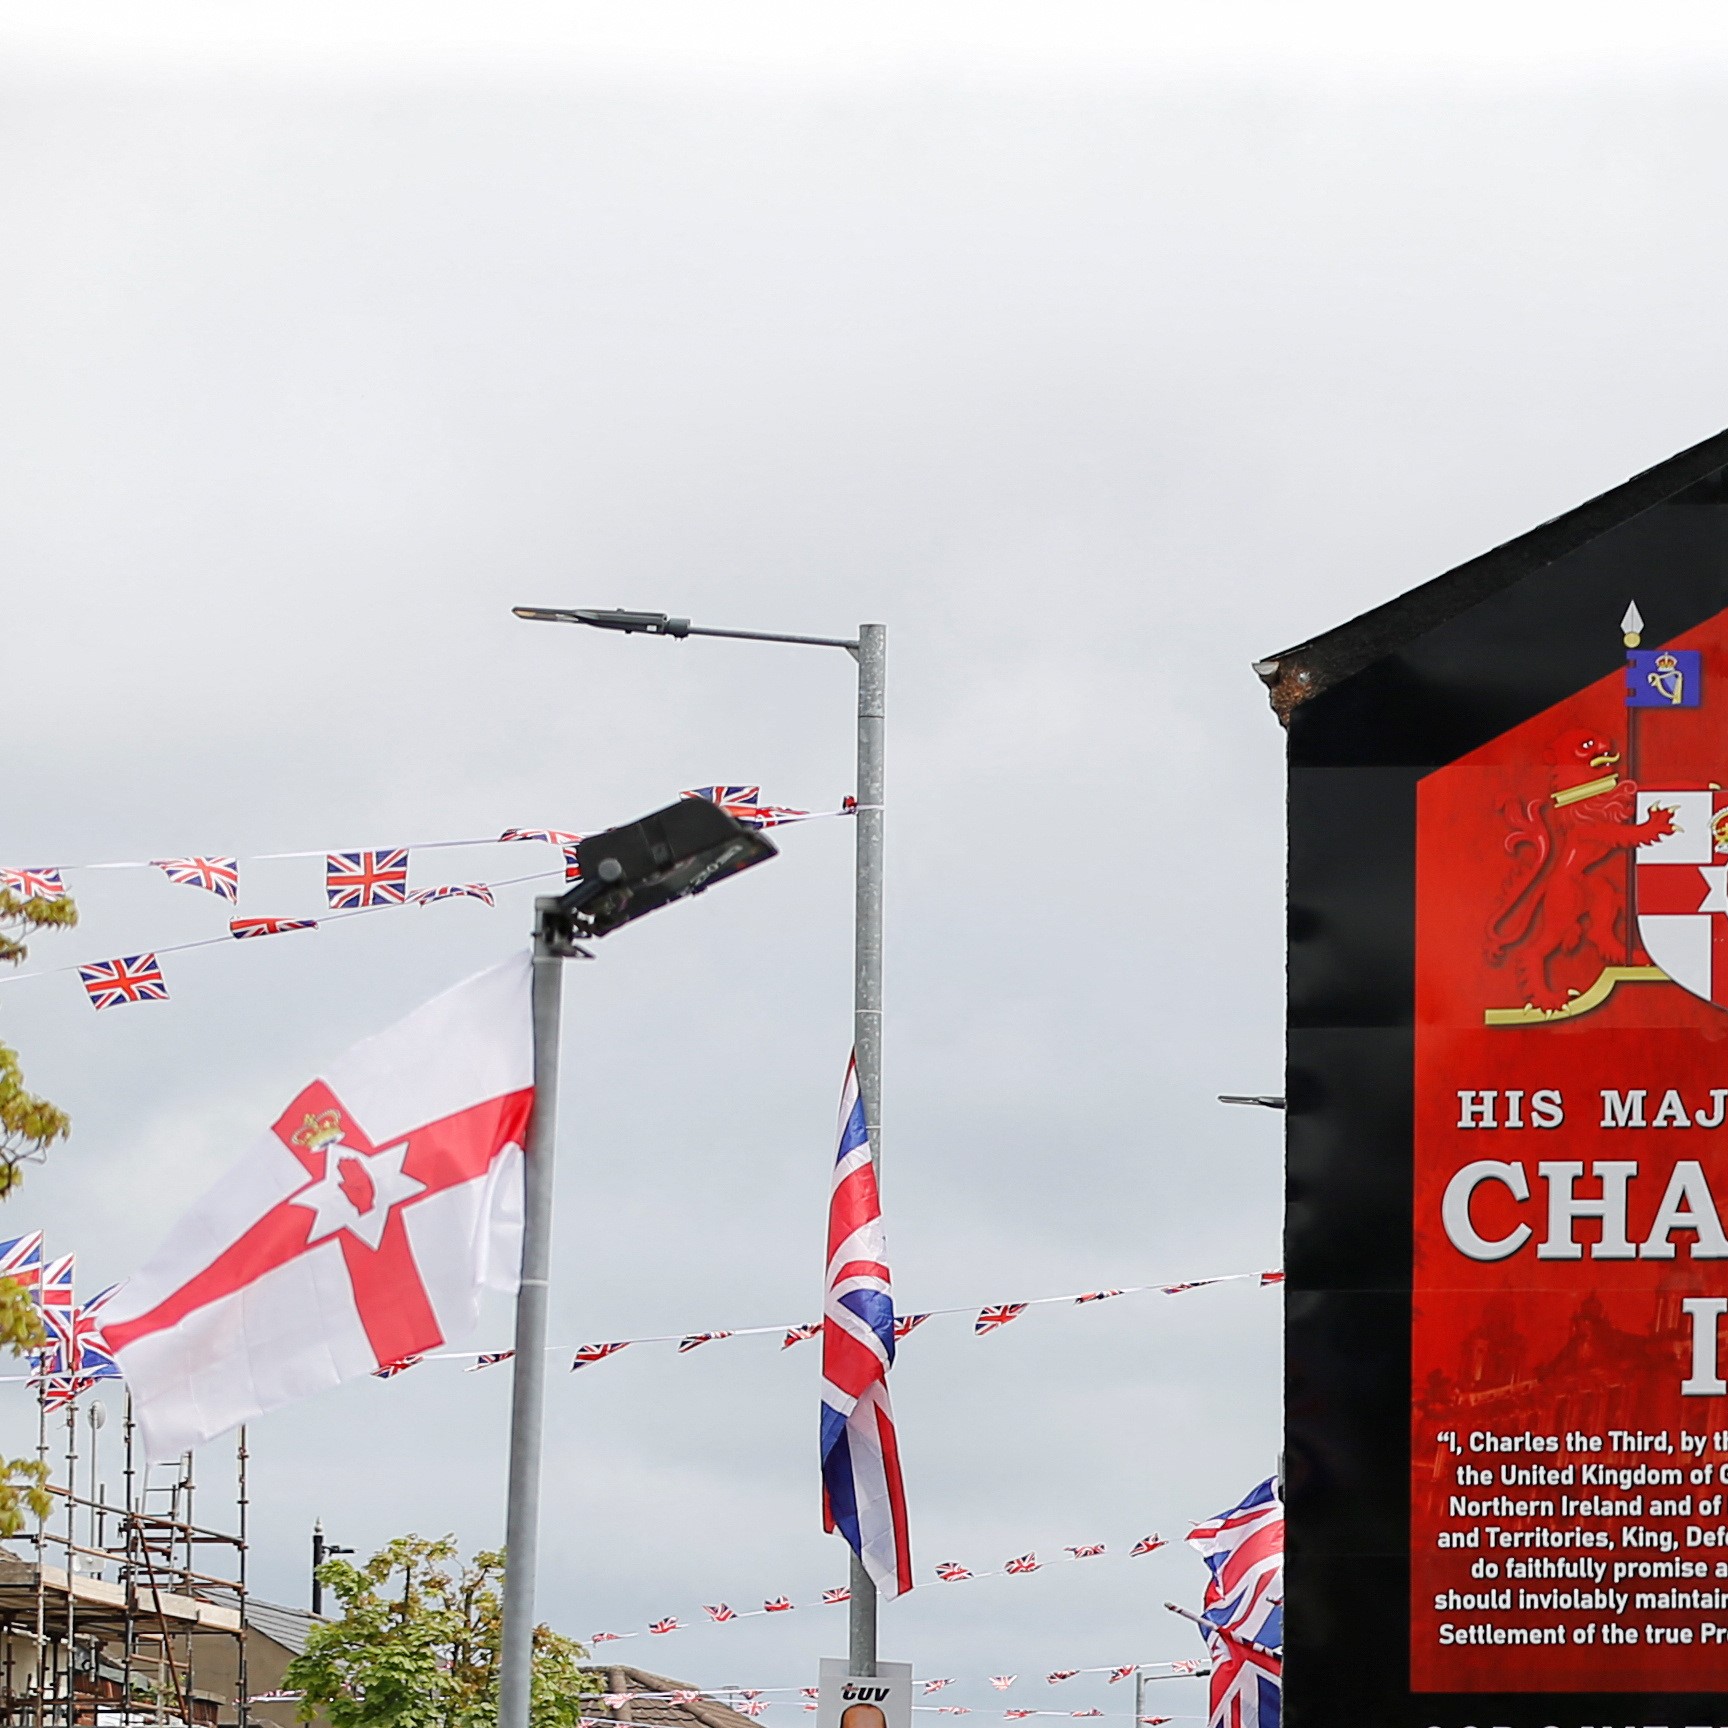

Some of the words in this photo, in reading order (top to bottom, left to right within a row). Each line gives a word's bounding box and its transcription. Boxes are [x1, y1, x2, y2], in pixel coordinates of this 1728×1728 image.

[1456, 1089, 1564, 1128] HIS
[1436, 1431, 1462, 1456] “I,
[1469, 1431, 1559, 1453] Charles
[1565, 1430, 1603, 1452] the
[1607, 1430, 1674, 1455] Third,
[1680, 1430, 1708, 1457] by
[1456, 1464, 1493, 1486] the
[1500, 1464, 1574, 1486] United
[1581, 1463, 1683, 1490] Kingdom
[1689, 1463, 1713, 1485] of
[1449, 1495, 1554, 1517] Northern
[1561, 1494, 1642, 1517] Ireland
[1649, 1494, 1692, 1516] and
[1698, 1494, 1722, 1516] of
[1437, 1526, 1479, 1548] and
[1484, 1526, 1615, 1551] Territories,
[1622, 1525, 1679, 1553] King,
[1471, 1557, 1499, 1579] do
[1505, 1556, 1607, 1584] faithfully
[1613, 1556, 1708, 1584] promise
[1434, 1588, 1512, 1610] should
[1519, 1588, 1629, 1615] inviolably
[1438, 1623, 1566, 1645] Settlement
[1572, 1623, 1596, 1644] of
[1601, 1622, 1639, 1644] the
[1645, 1624, 1694, 1644] true
